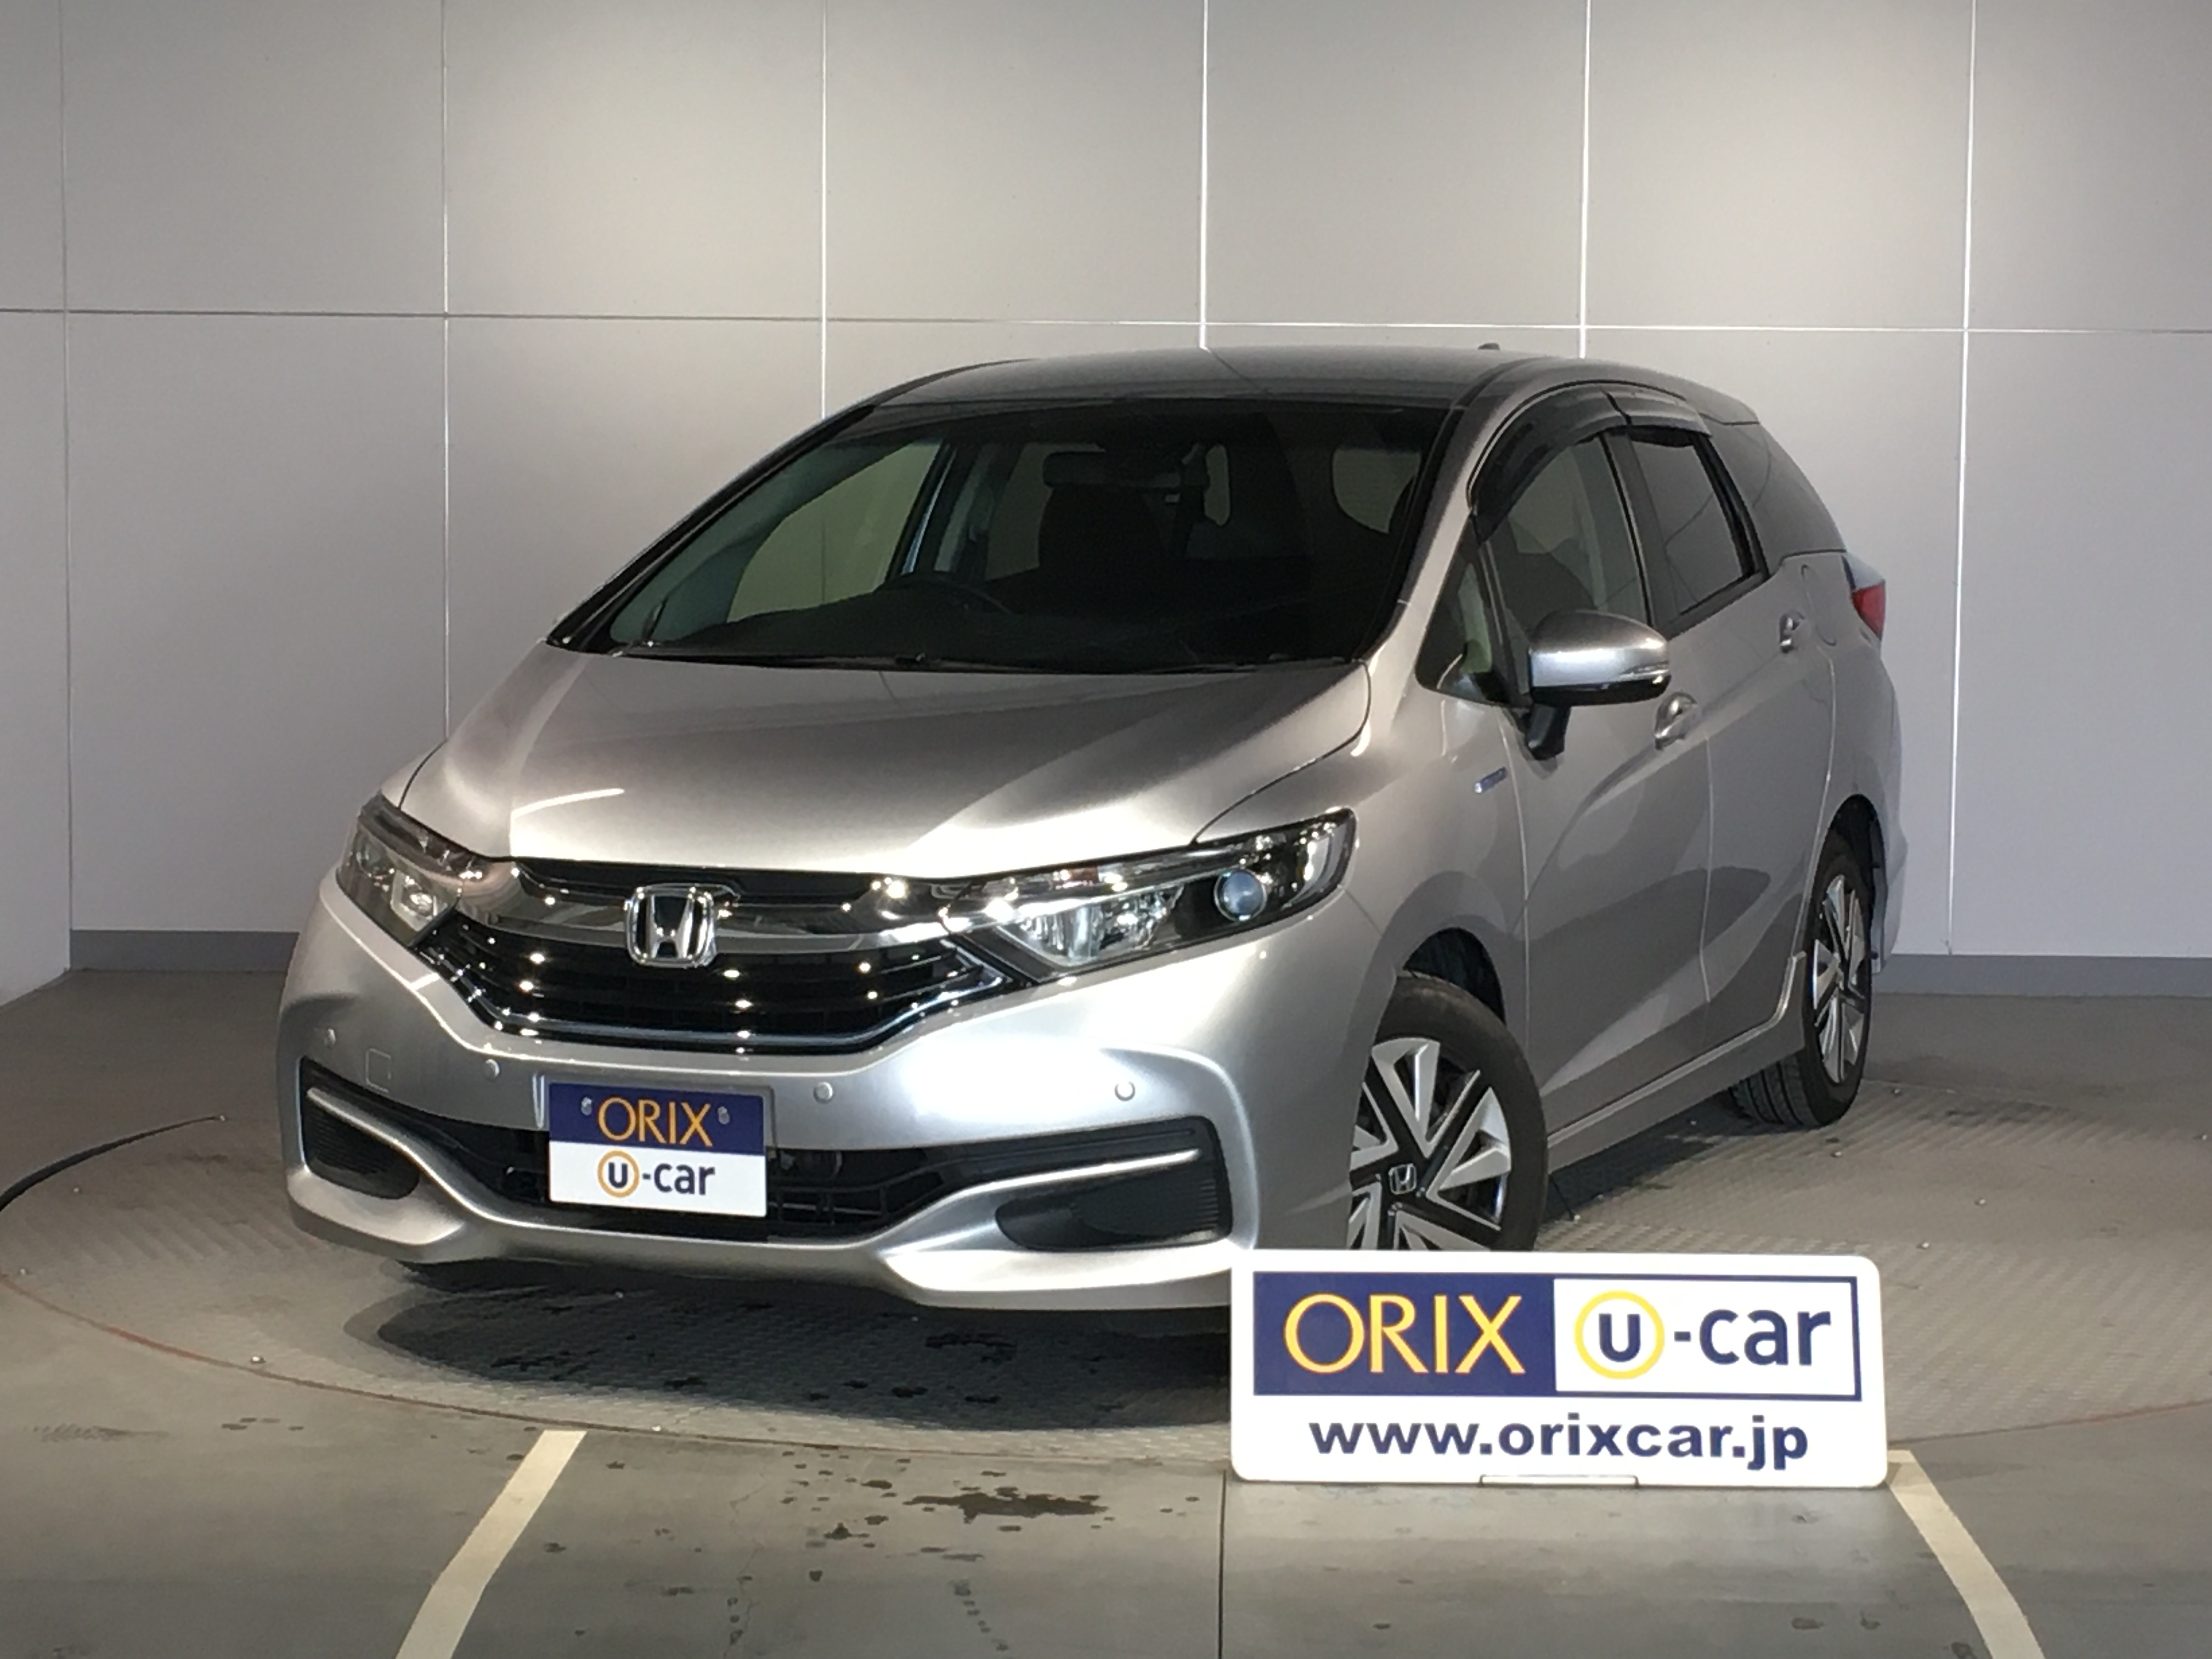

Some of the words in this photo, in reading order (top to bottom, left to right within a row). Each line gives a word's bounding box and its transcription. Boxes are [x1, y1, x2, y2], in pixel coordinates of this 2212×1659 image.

[597, 1097, 713, 1147] ORIX
[607, 1161, 715, 1195] u-car
[1283, 1293, 1526, 1375] ORIX
[1597, 1307, 1832, 1367] u-car
[1308, 1412, 1809, 1471] www.orixcar.jp
